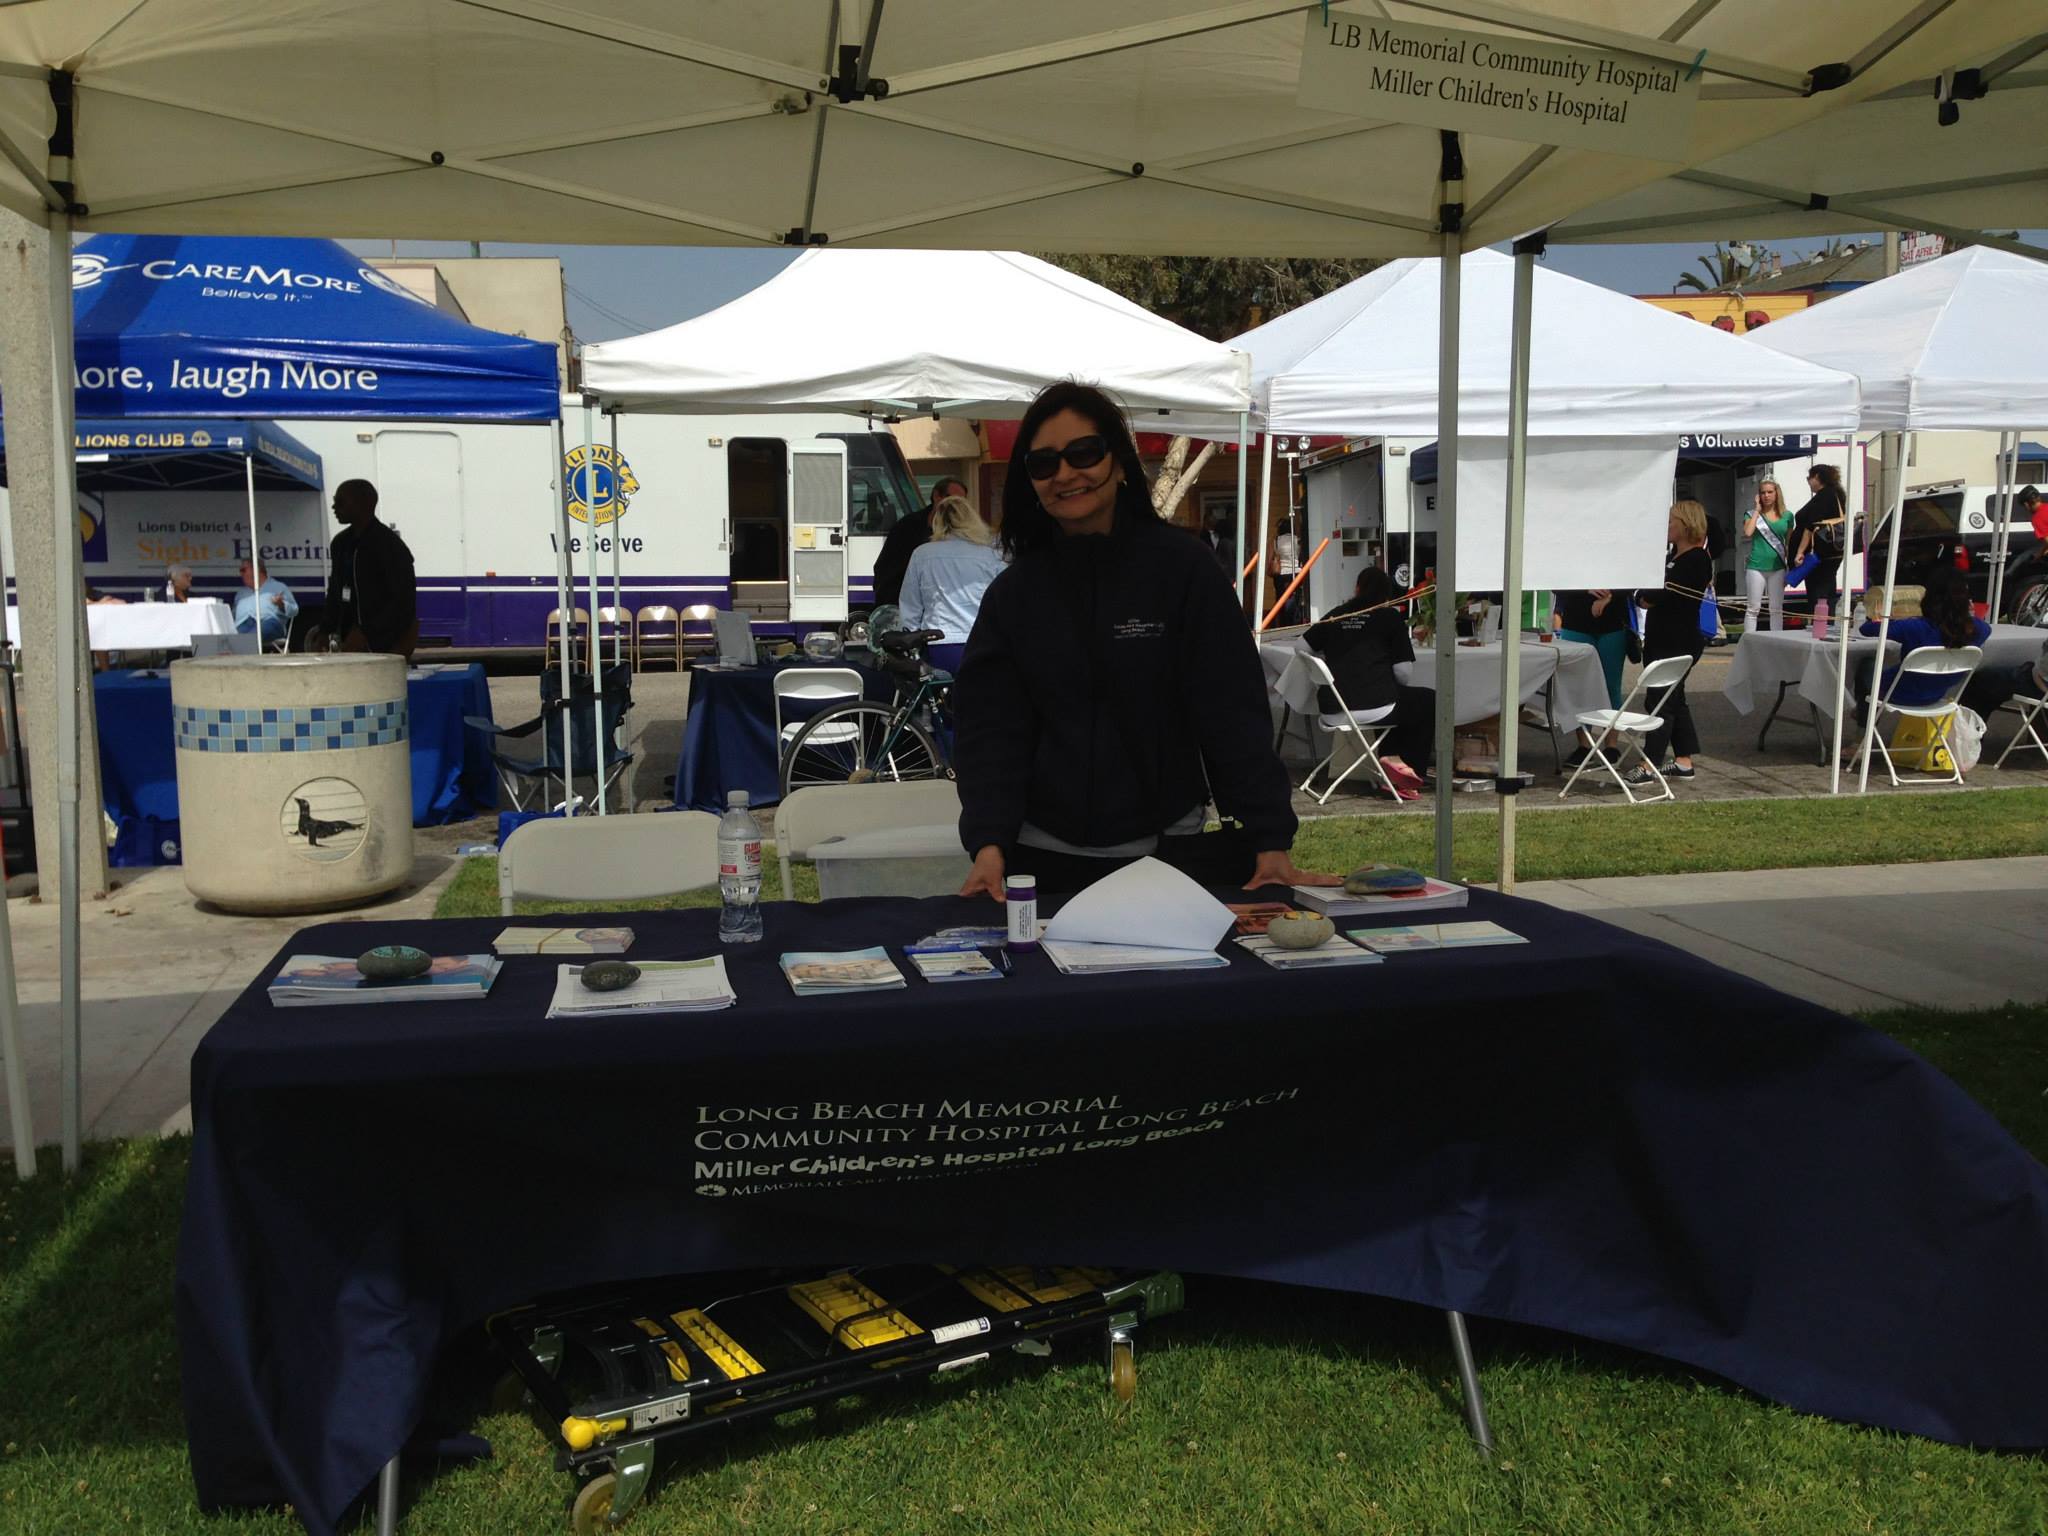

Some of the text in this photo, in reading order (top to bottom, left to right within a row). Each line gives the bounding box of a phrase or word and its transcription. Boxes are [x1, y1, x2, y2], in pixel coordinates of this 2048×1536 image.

[1329, 21, 1680, 95] LB Memorial Community Hospital
[1370, 67, 1628, 125] Miller Children's Hospital
[202, 287, 278, 301] Believe
[171, 359, 270, 398] laugh
[281, 362, 378, 391] More
[75, 433, 185, 448] LIONS CLUB
[569, 448, 620, 466] LION
[138, 521, 176, 533] Lions
[180, 521, 229, 533] District
[137, 536, 209, 566] Sight
[694, 1087, 1300, 1151] COMMUNITY HOSPITAL LONG BEACH
[696, 1095, 1123, 1124] LONG BEACH MEMORIAL
[694, 1160, 785, 1180] Miller
[789, 1154, 936, 1175] Children's
[942, 1143, 1067, 1167] Hospital
[1072, 1135, 1140, 1153] Long
[1144, 1120, 1225, 1142] Beach
